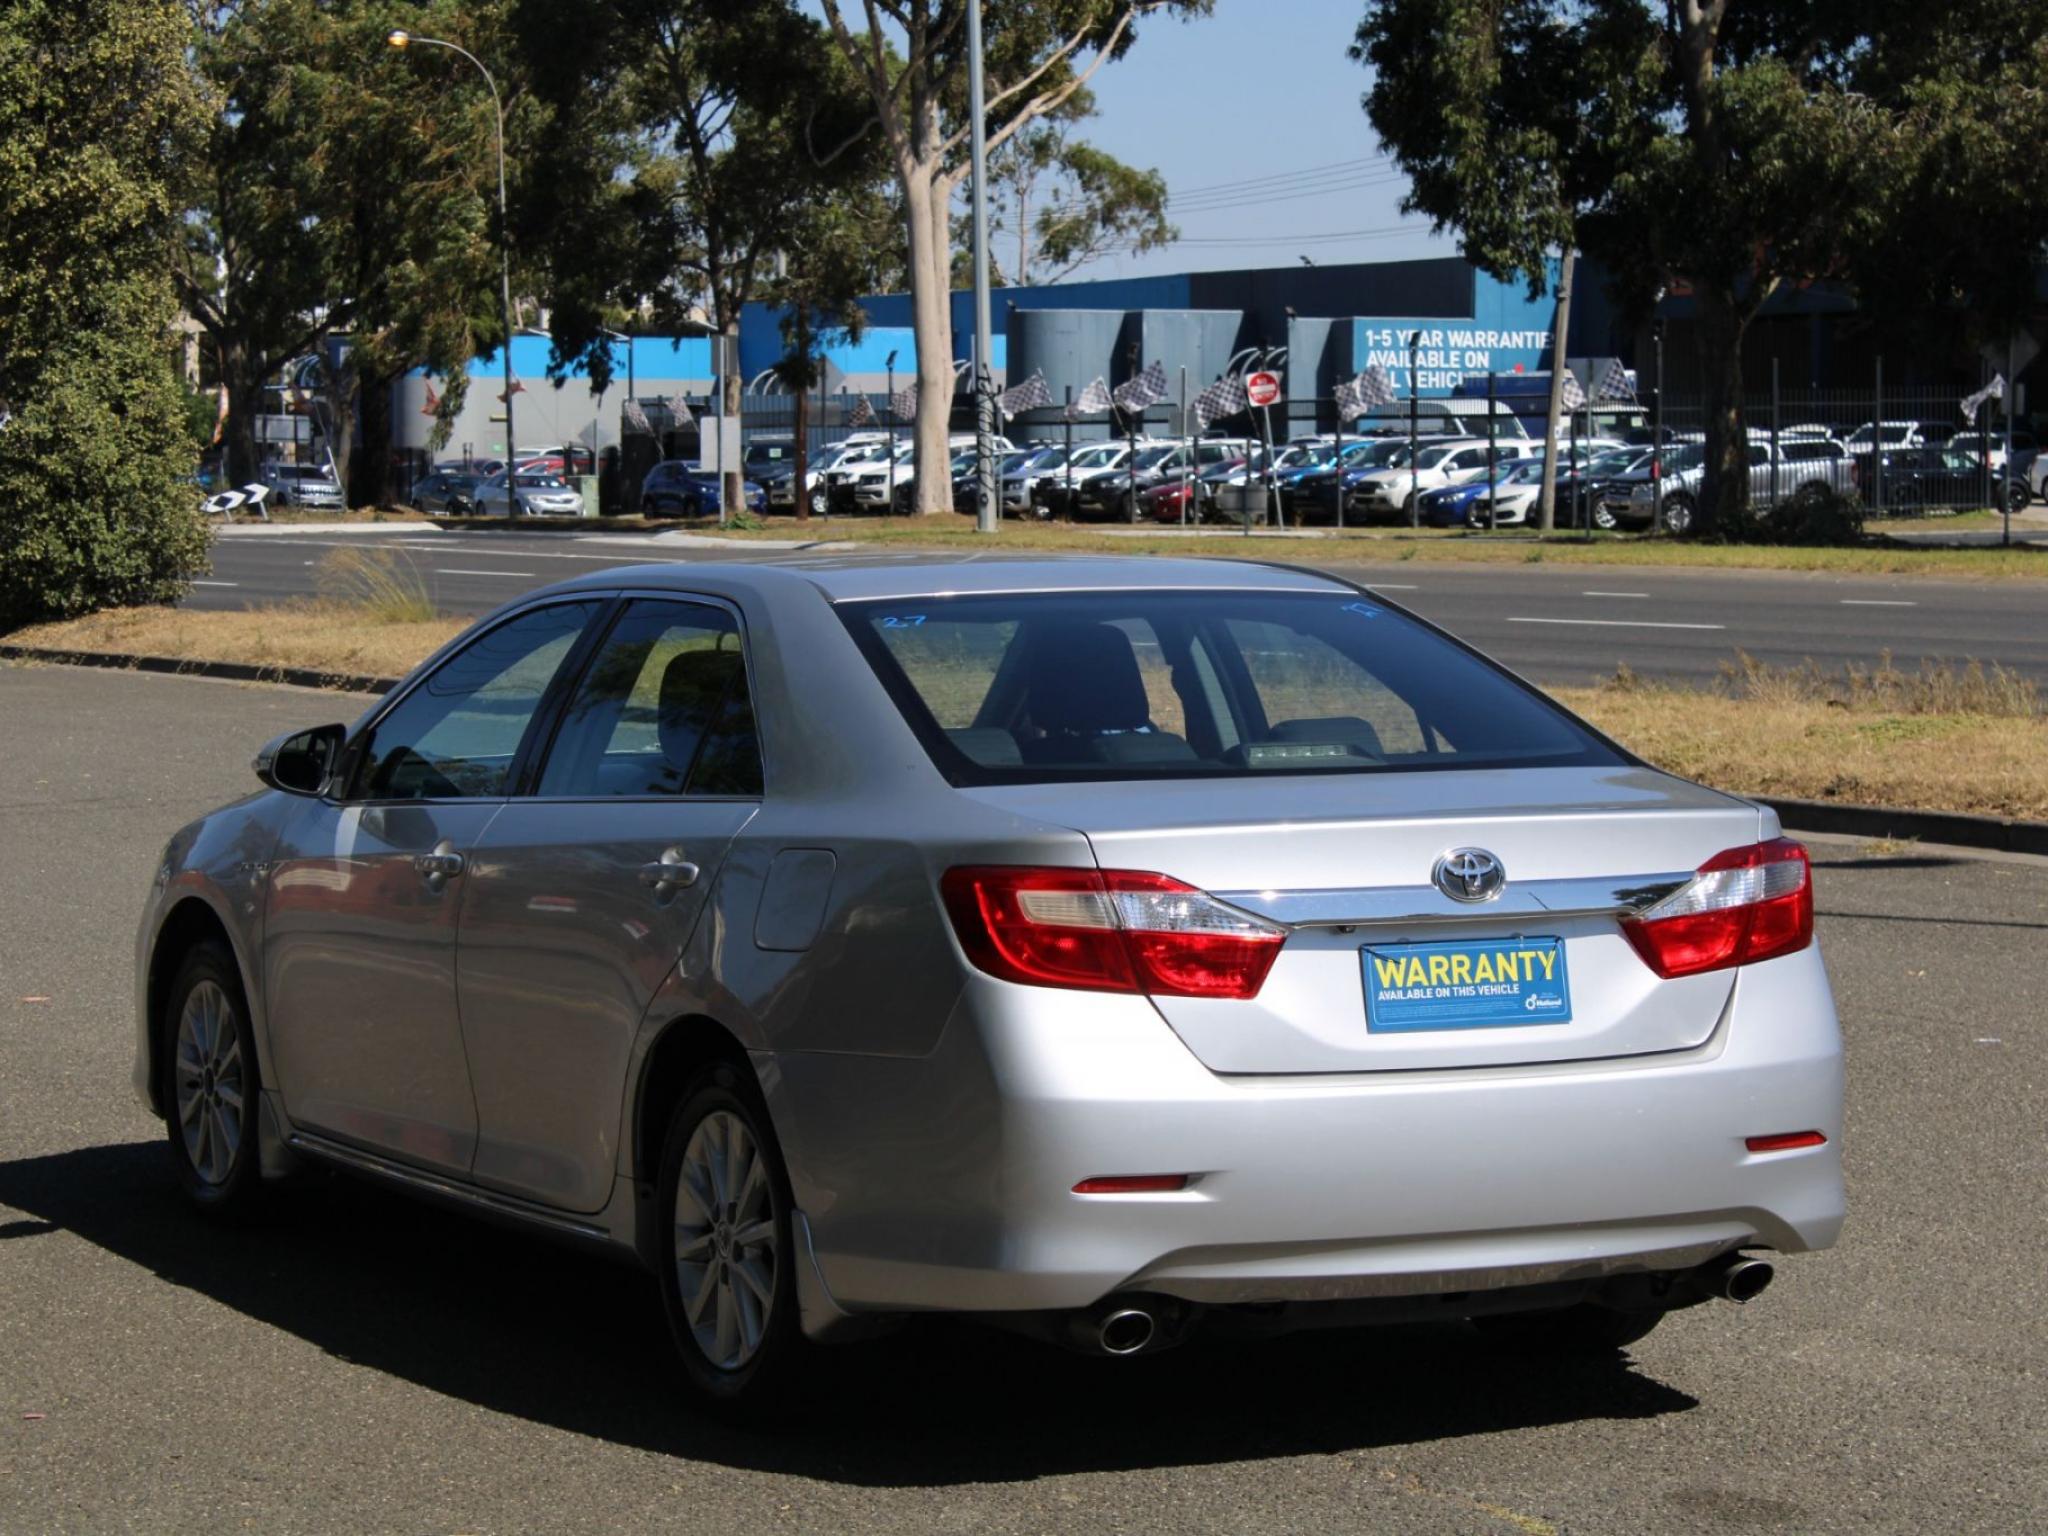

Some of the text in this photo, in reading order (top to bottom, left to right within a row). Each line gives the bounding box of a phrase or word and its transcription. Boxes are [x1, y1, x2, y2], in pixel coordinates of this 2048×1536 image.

[1366, 329, 1392, 347] 1-5
[1366, 350, 1489, 368] AVAILABLE ON
[883, 615, 926, 628] 27
[1375, 951, 1556, 988] WARRANTY
[1378, 983, 1520, 1001] AVAILABLE ON THIS VEHICLE
